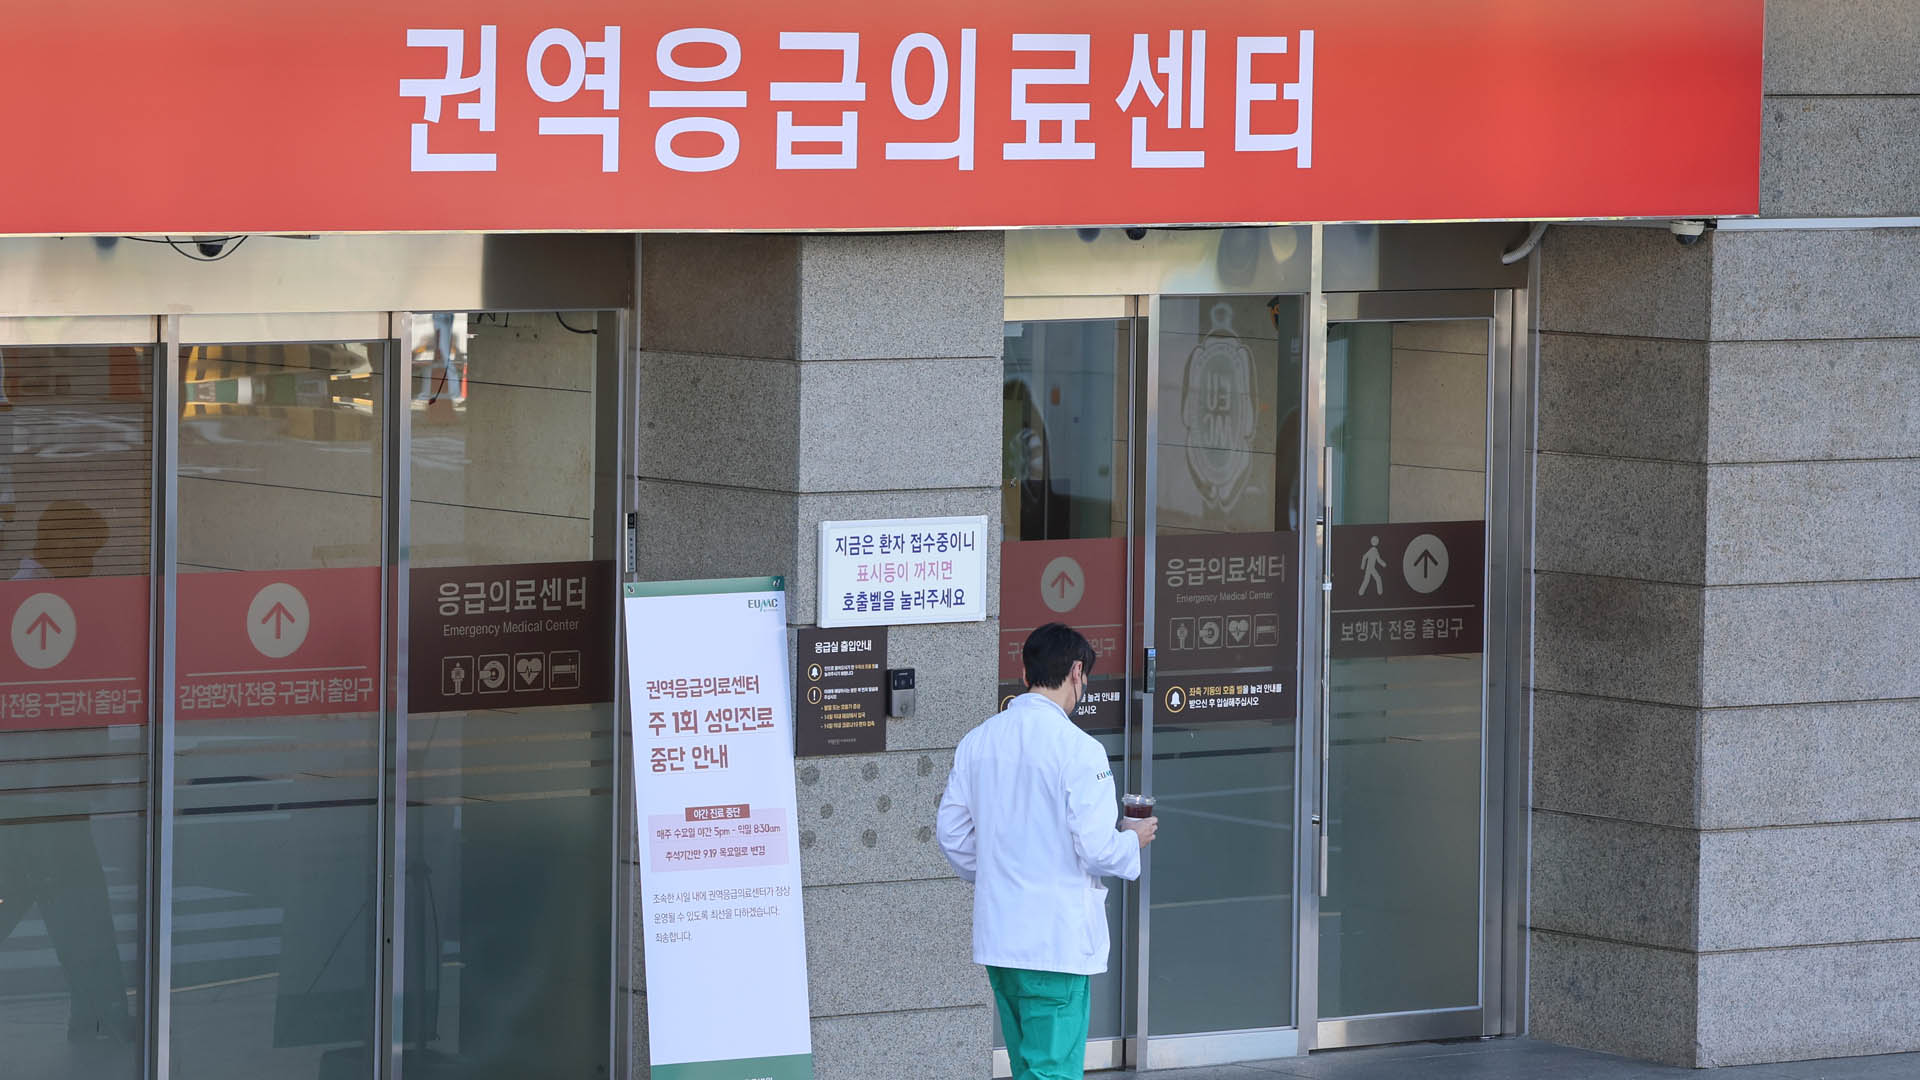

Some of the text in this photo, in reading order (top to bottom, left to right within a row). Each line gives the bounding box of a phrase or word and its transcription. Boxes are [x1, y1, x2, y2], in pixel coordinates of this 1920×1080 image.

[401, 26, 1315, 173] 권역응급의료센터
[835, 531, 974, 556] 지금은 환자 접수중이니
[857, 560, 952, 583] 표시등이 꺼지면
[1166, 554, 1286, 587] 응급의료센터
[438, 577, 586, 616] 응급의료센터
[748, 599, 778, 612] EUMC
[842, 588, 965, 612] 호출벨을 눌러주세요
[1177, 591, 1272, 604] Emergency Medical Center
[444, 619, 578, 637] Emergency Medical Center
[1341, 618, 1463, 641] 보행자 전용 출입구
[815, 640, 871, 653] 응급실 출입안내
[179, 677, 374, 710] 감염환자 전용 구급차 출입구
[647, 675, 759, 699] 권역응급의료센터
[9, 692, 40, 718] 전용
[44, 690, 91, 716] 구급차
[95, 689, 142, 715] 출입구
[1209, 699, 1215, 707] 후
[649, 707, 773, 736] 주 1회 성인진료
[651, 744, 728, 772] 중단 안내
[694, 809, 708, 819] 야간
[657, 829, 671, 840] 매주
[674, 827, 695, 838] 수요일
[698, 827, 712, 838] 야간
[714, 827, 729, 838] 5pm
[738, 825, 752, 834] 익일
[666, 850, 700, 861] 추석기간만
[720, 847, 748, 857] 목요일로
[676, 893, 690, 903] 시일
[692, 891, 706, 901] 내에
[708, 888, 774, 901] 권역응급의료센터가
[775, 886, 791, 897] 정상
[677, 913, 685, 922] 수
